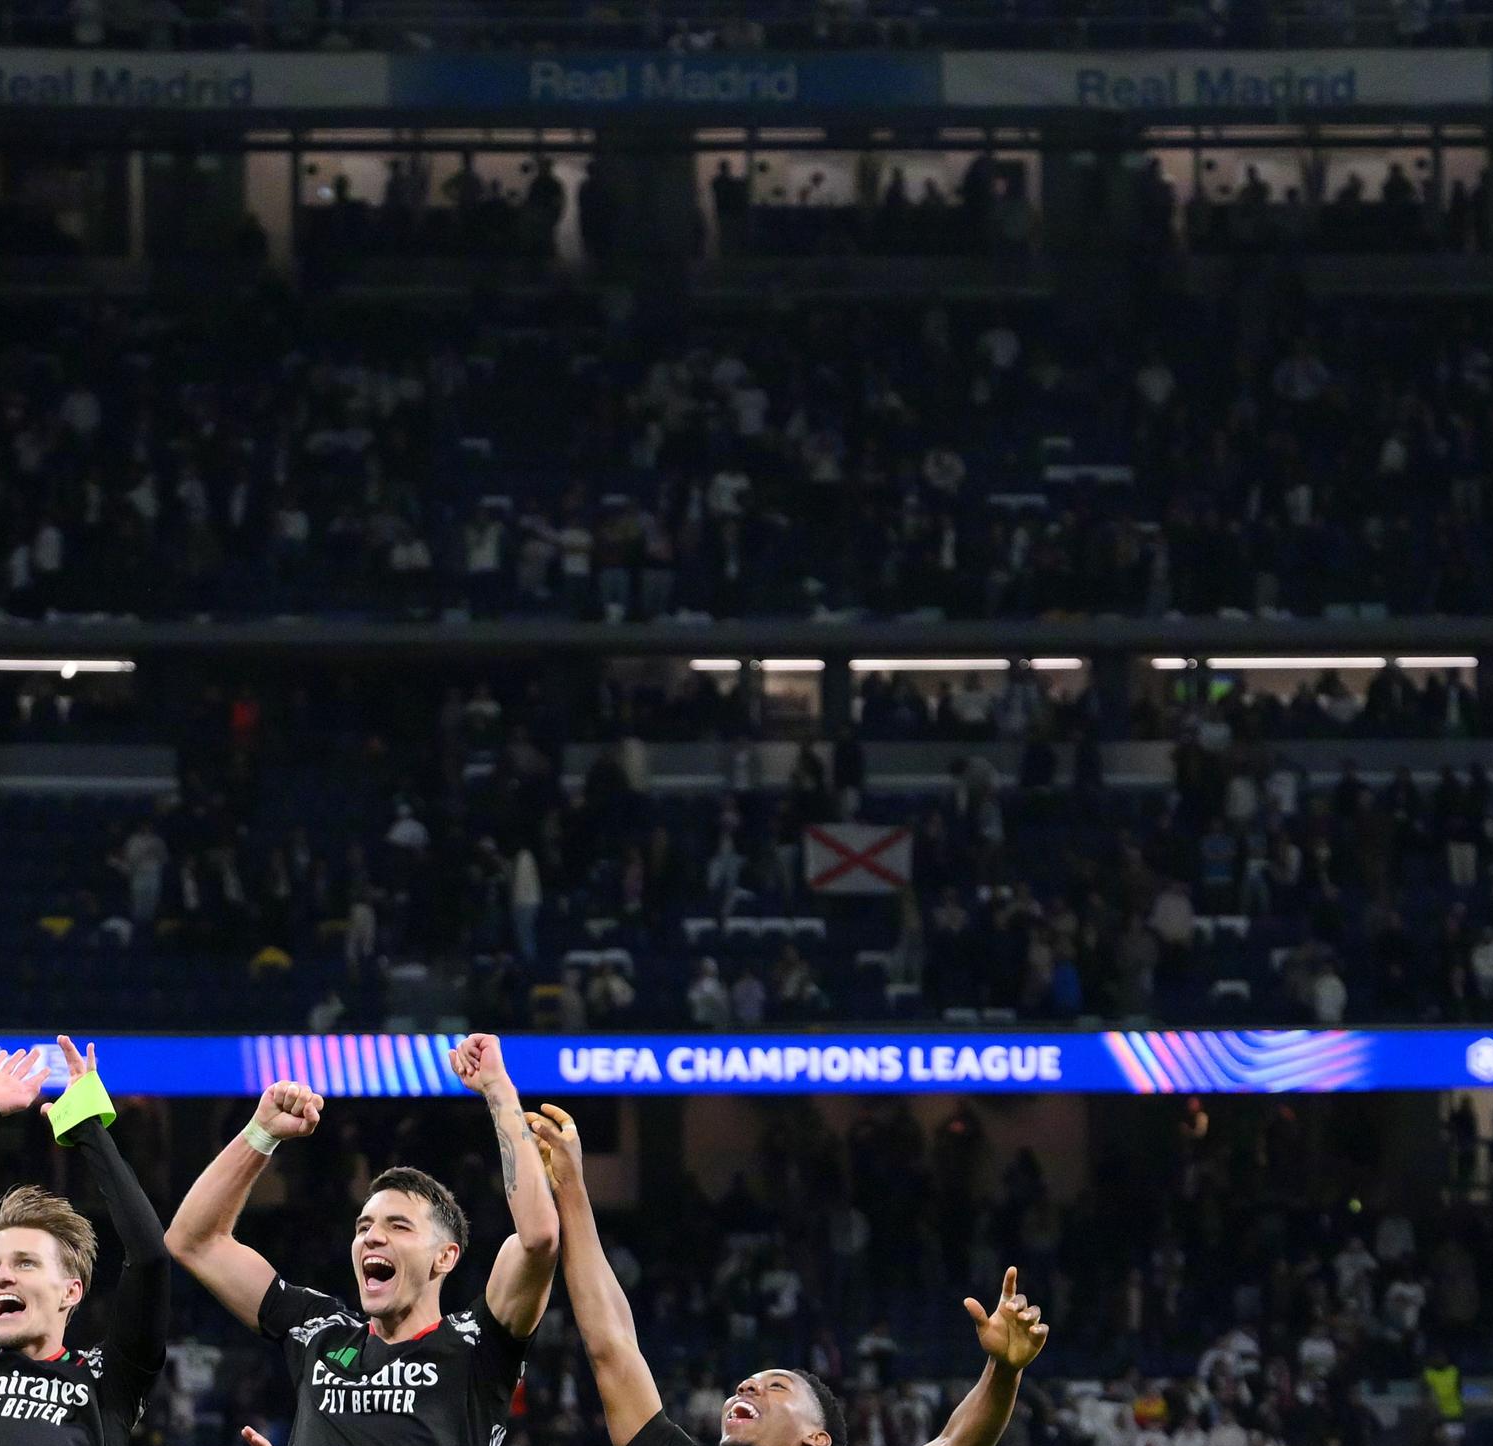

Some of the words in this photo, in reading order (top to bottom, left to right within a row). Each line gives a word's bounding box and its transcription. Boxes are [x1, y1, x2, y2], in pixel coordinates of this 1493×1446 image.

[93, 66, 254, 107] Madrid
[529, 61, 626, 102] Real
[641, 60, 798, 103] Madrid
[1076, 67, 1177, 109] Real
[1193, 66, 1357, 107] Madrid
[557, 1046, 662, 1083] UEFA
[666, 1045, 904, 1083] CHAMPIONS
[908, 1045, 1063, 1083] LEAGUE
[0, 1398, 69, 1426] BETTER
[318, 1388, 346, 1414] FLY
[351, 1388, 416, 1414] BETTER
